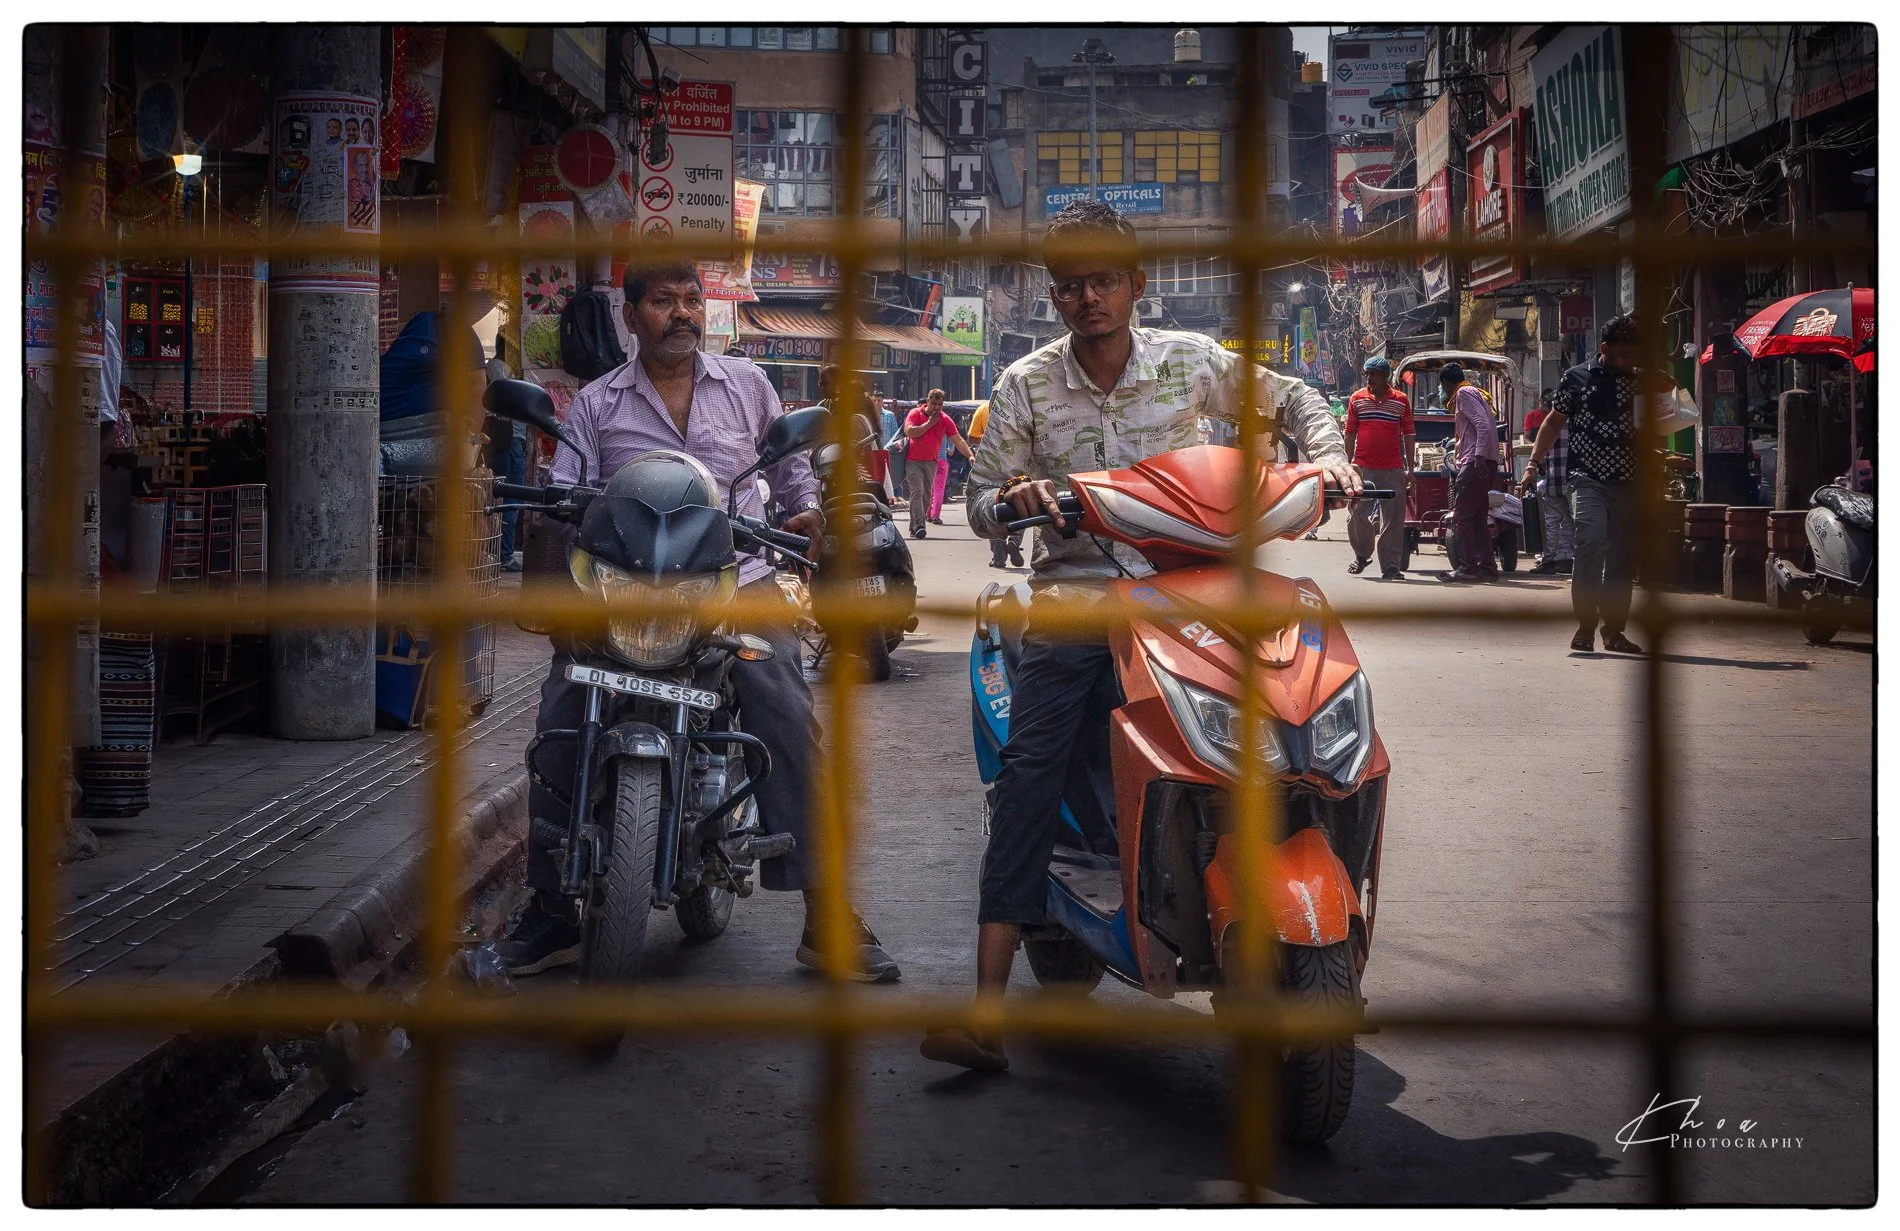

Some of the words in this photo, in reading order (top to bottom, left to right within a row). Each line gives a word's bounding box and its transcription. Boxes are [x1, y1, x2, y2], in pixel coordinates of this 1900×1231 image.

[1355, 63, 1379, 71] VIVID
[686, 83, 718, 100] वर्जित
[673, 100, 730, 114] Prohibited
[1536, 27, 1622, 188] ASHOKA
[680, 116, 691, 126] to
[694, 116, 701, 126] 9
[704, 117, 725, 130] PM)
[684, 163, 723, 184] जुर्माना
[1601, 152, 1627, 208] STORE
[687, 193, 729, 207] 20000/-
[1104, 188, 1161, 203] OPTICALS
[1475, 188, 1502, 229] LAHORE
[681, 216, 725, 232] Penalty
[1179, 621, 1225, 648] EV
[589, 669, 611, 686] DL
[977, 662, 1006, 695] GBG
